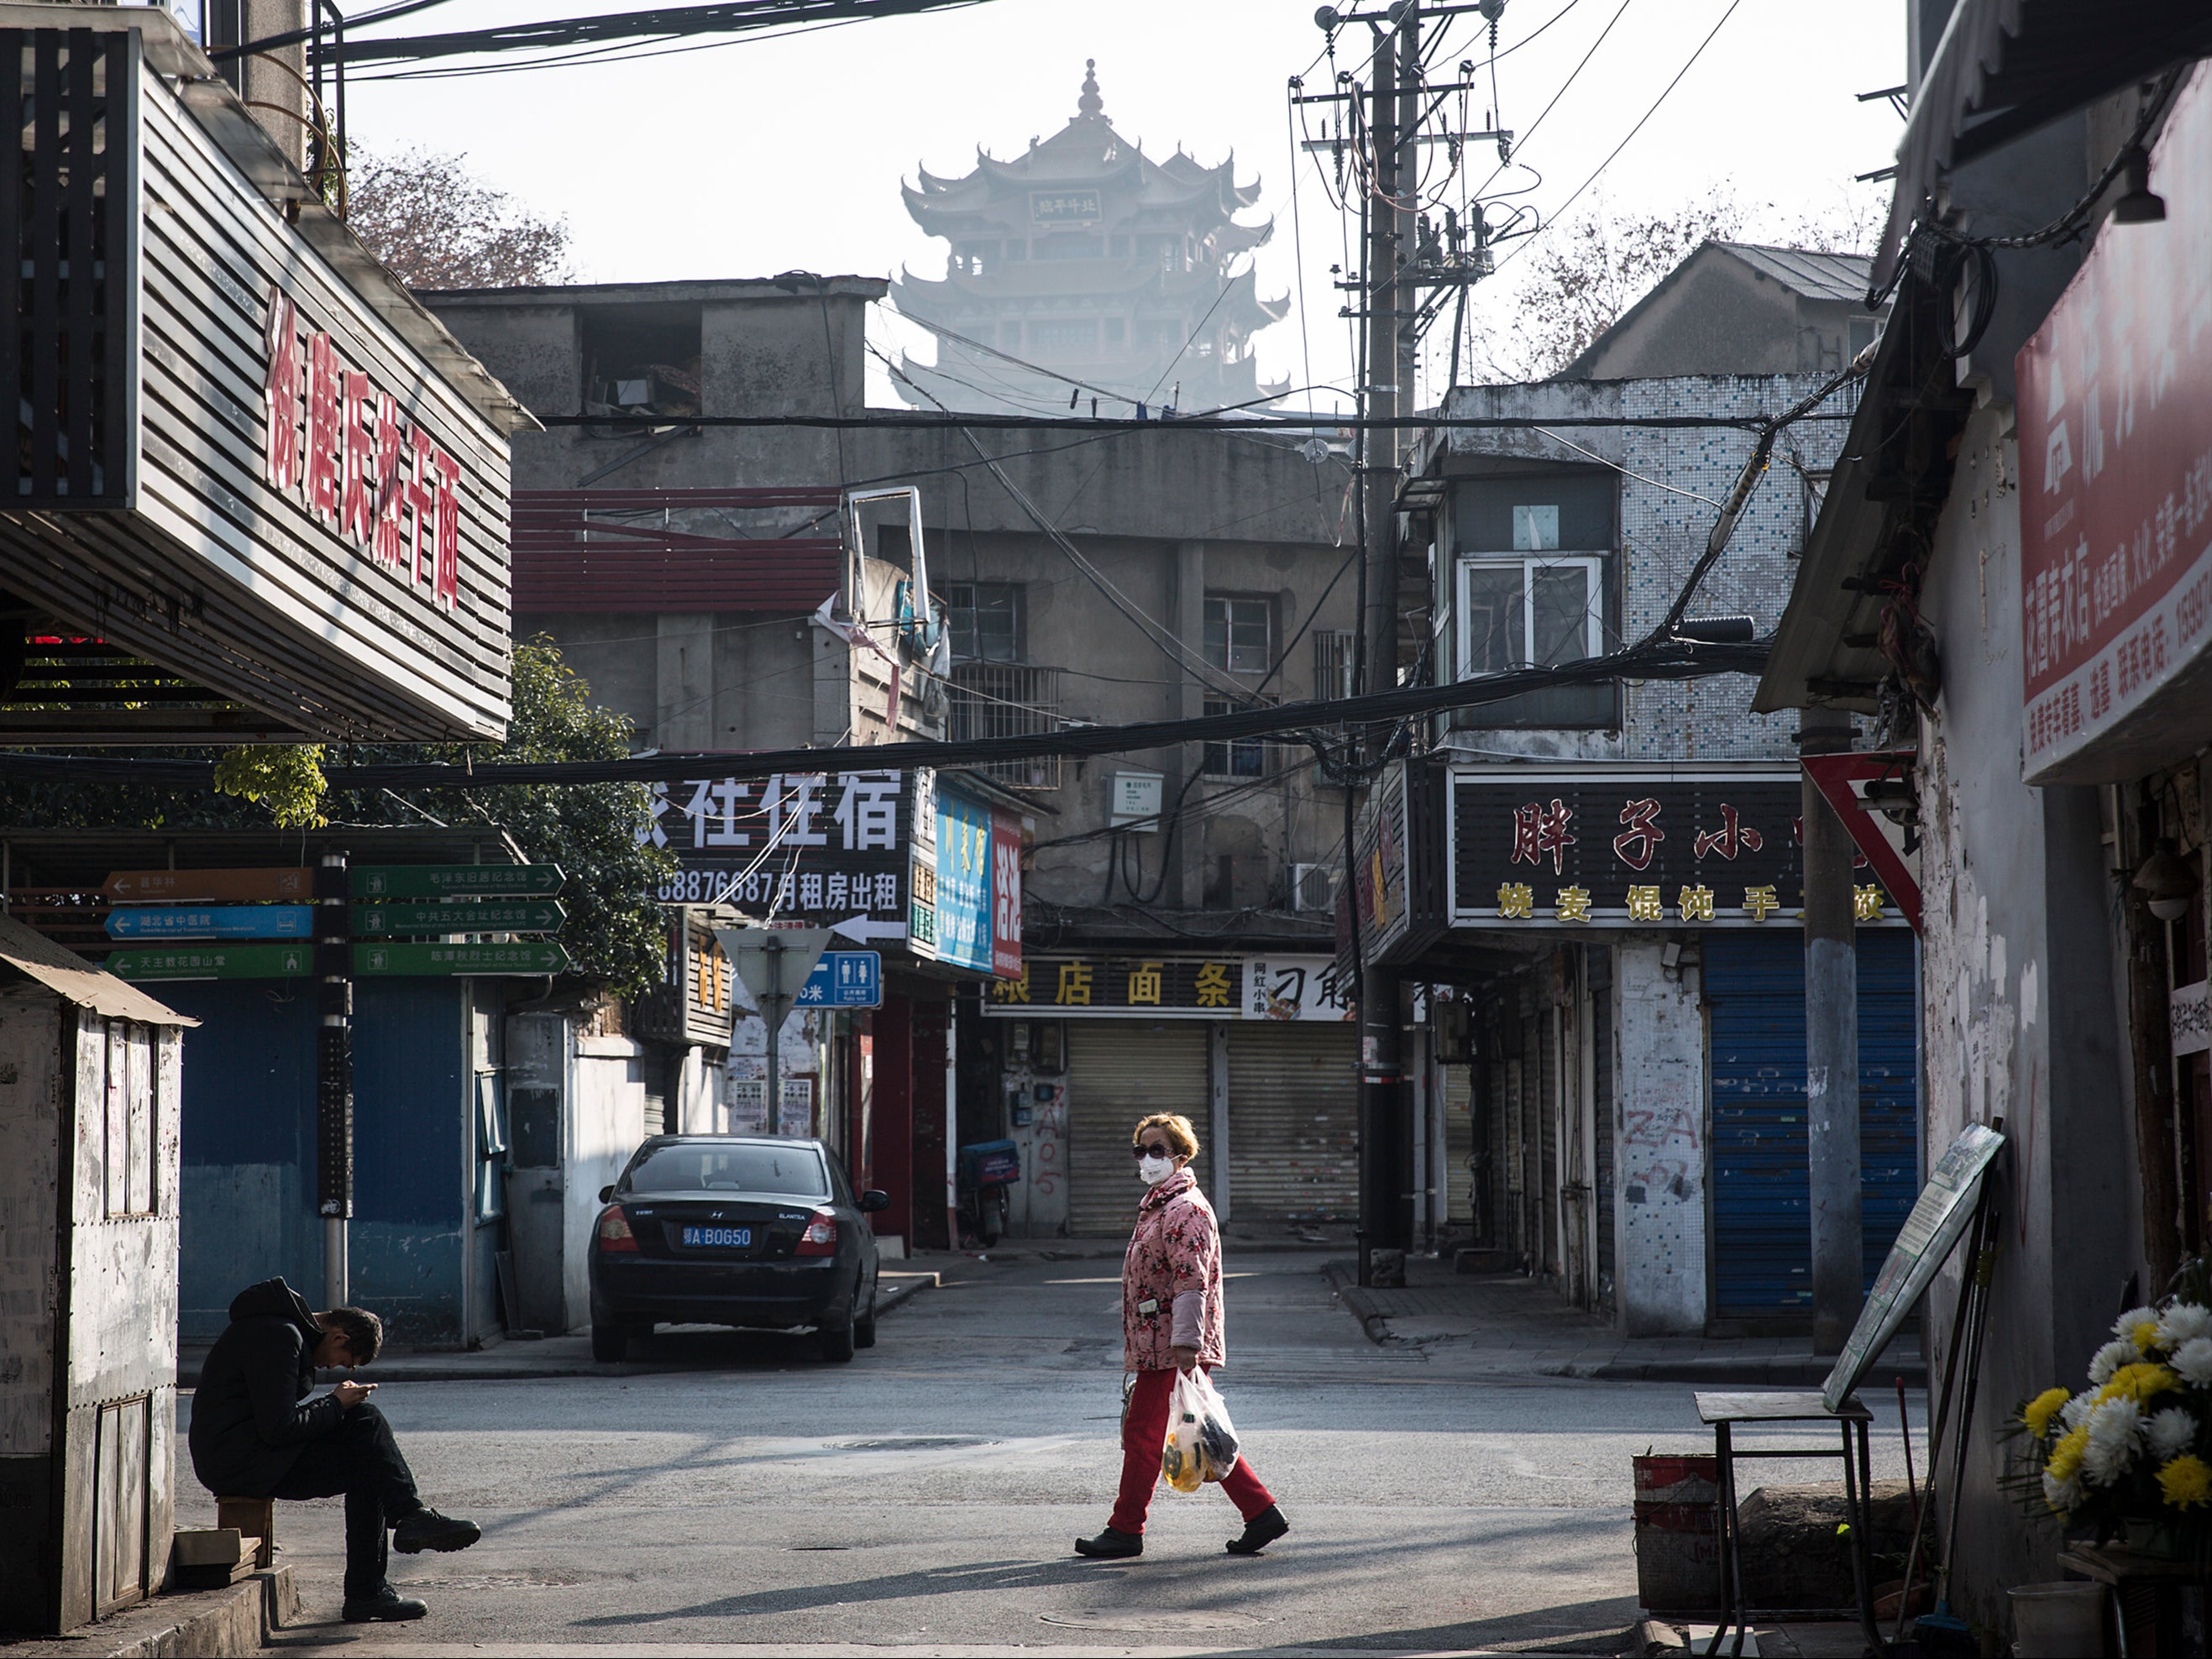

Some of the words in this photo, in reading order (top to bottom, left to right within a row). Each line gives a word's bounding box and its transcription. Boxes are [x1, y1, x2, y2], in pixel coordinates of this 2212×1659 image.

[2025, 531, 2090, 685] 花圈寿衣店
[429, 871, 527, 883] 毛泽东旧居纪念馆
[1497, 881, 1884, 923] 烧麦馄饨手饺
[140, 914, 211, 926] 湖北省中医院
[416, 909, 527, 922] 中共五大会址纪念馆
[140, 955, 225, 968] 天主教花园山堂
[431, 950, 532, 962] 陈潭秋烈士纪念馆
[1253, 962, 1266, 1014] 网红小串
